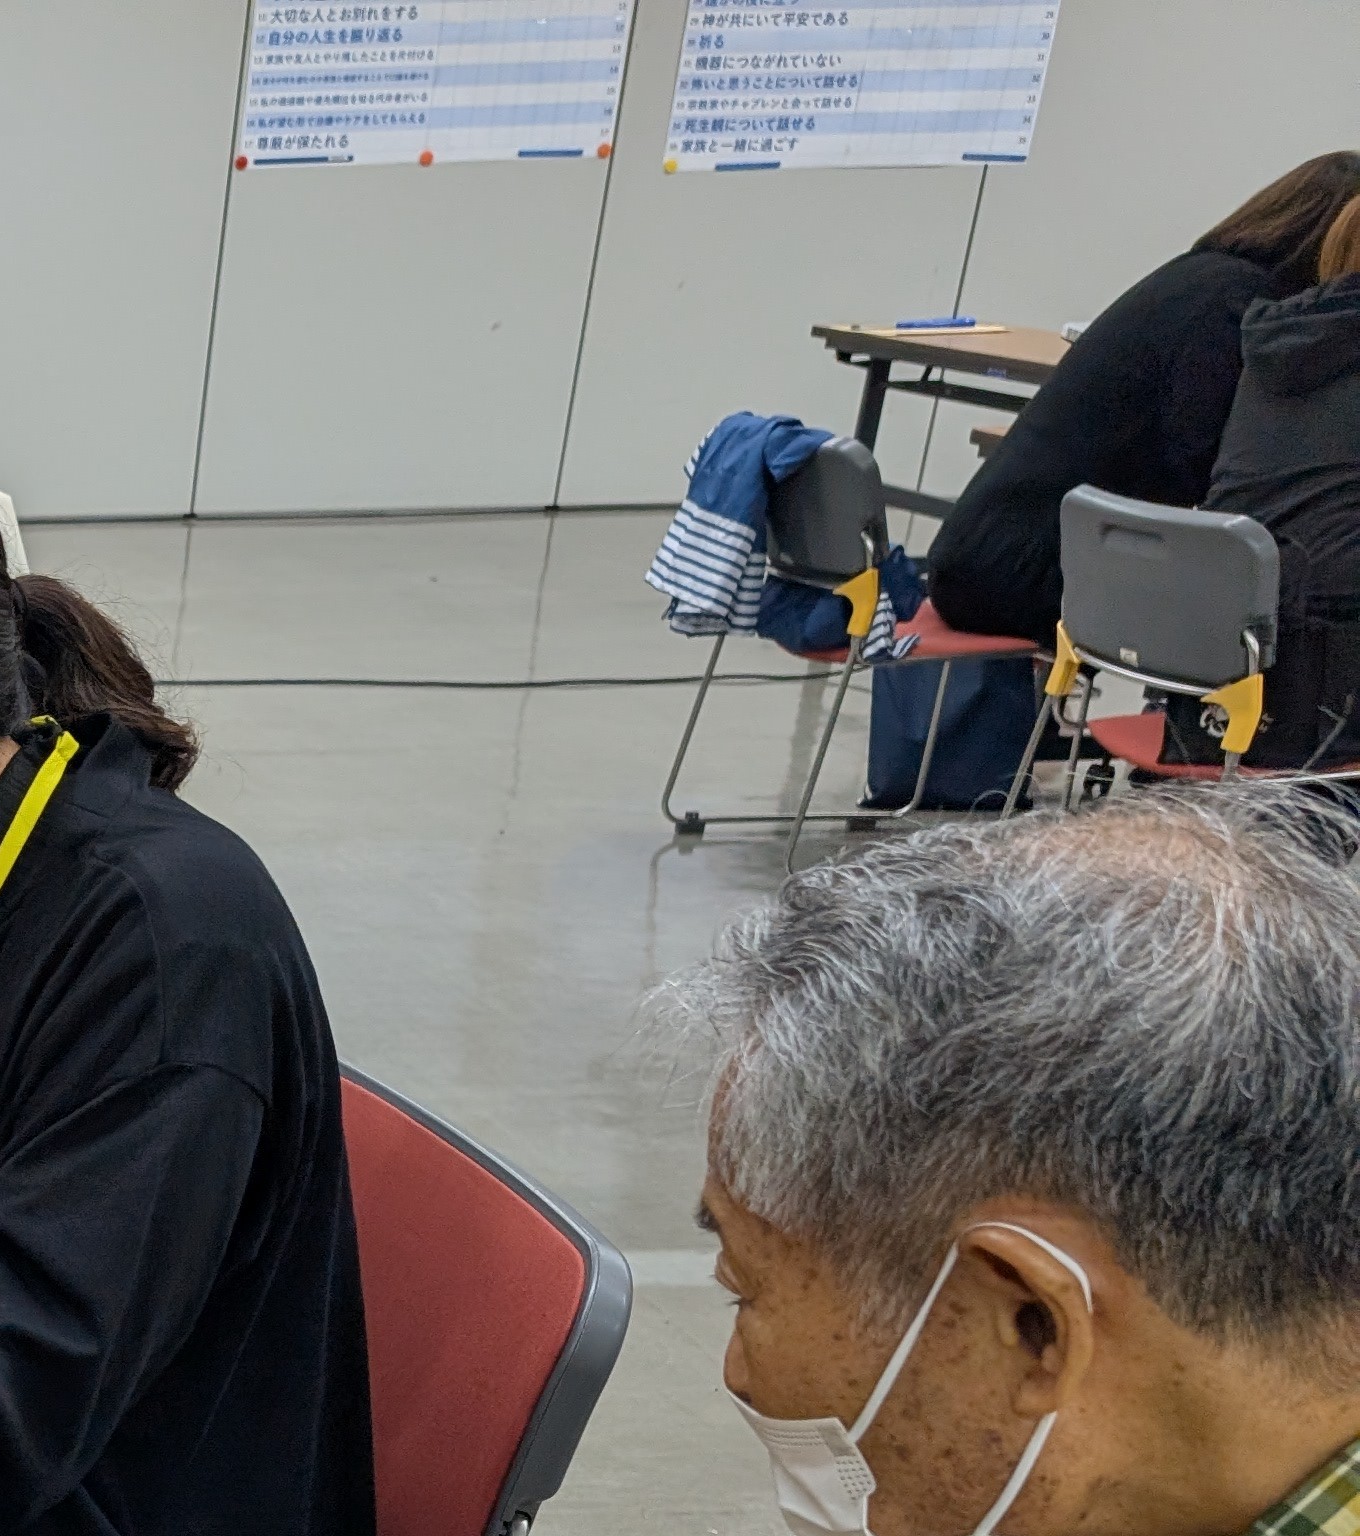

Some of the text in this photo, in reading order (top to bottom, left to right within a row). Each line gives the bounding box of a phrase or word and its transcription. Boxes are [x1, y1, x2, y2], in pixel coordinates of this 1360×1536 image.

[271, 5, 418, 24] 大切な人とお別れをする
[702, 12, 849, 28] 神が共にいて平安である
[268, 26, 402, 46] 自分の人生を振り返る
[698, 34, 724, 49] 祈る
[682, 136, 798, 153] 家族と一緒に過ごす
